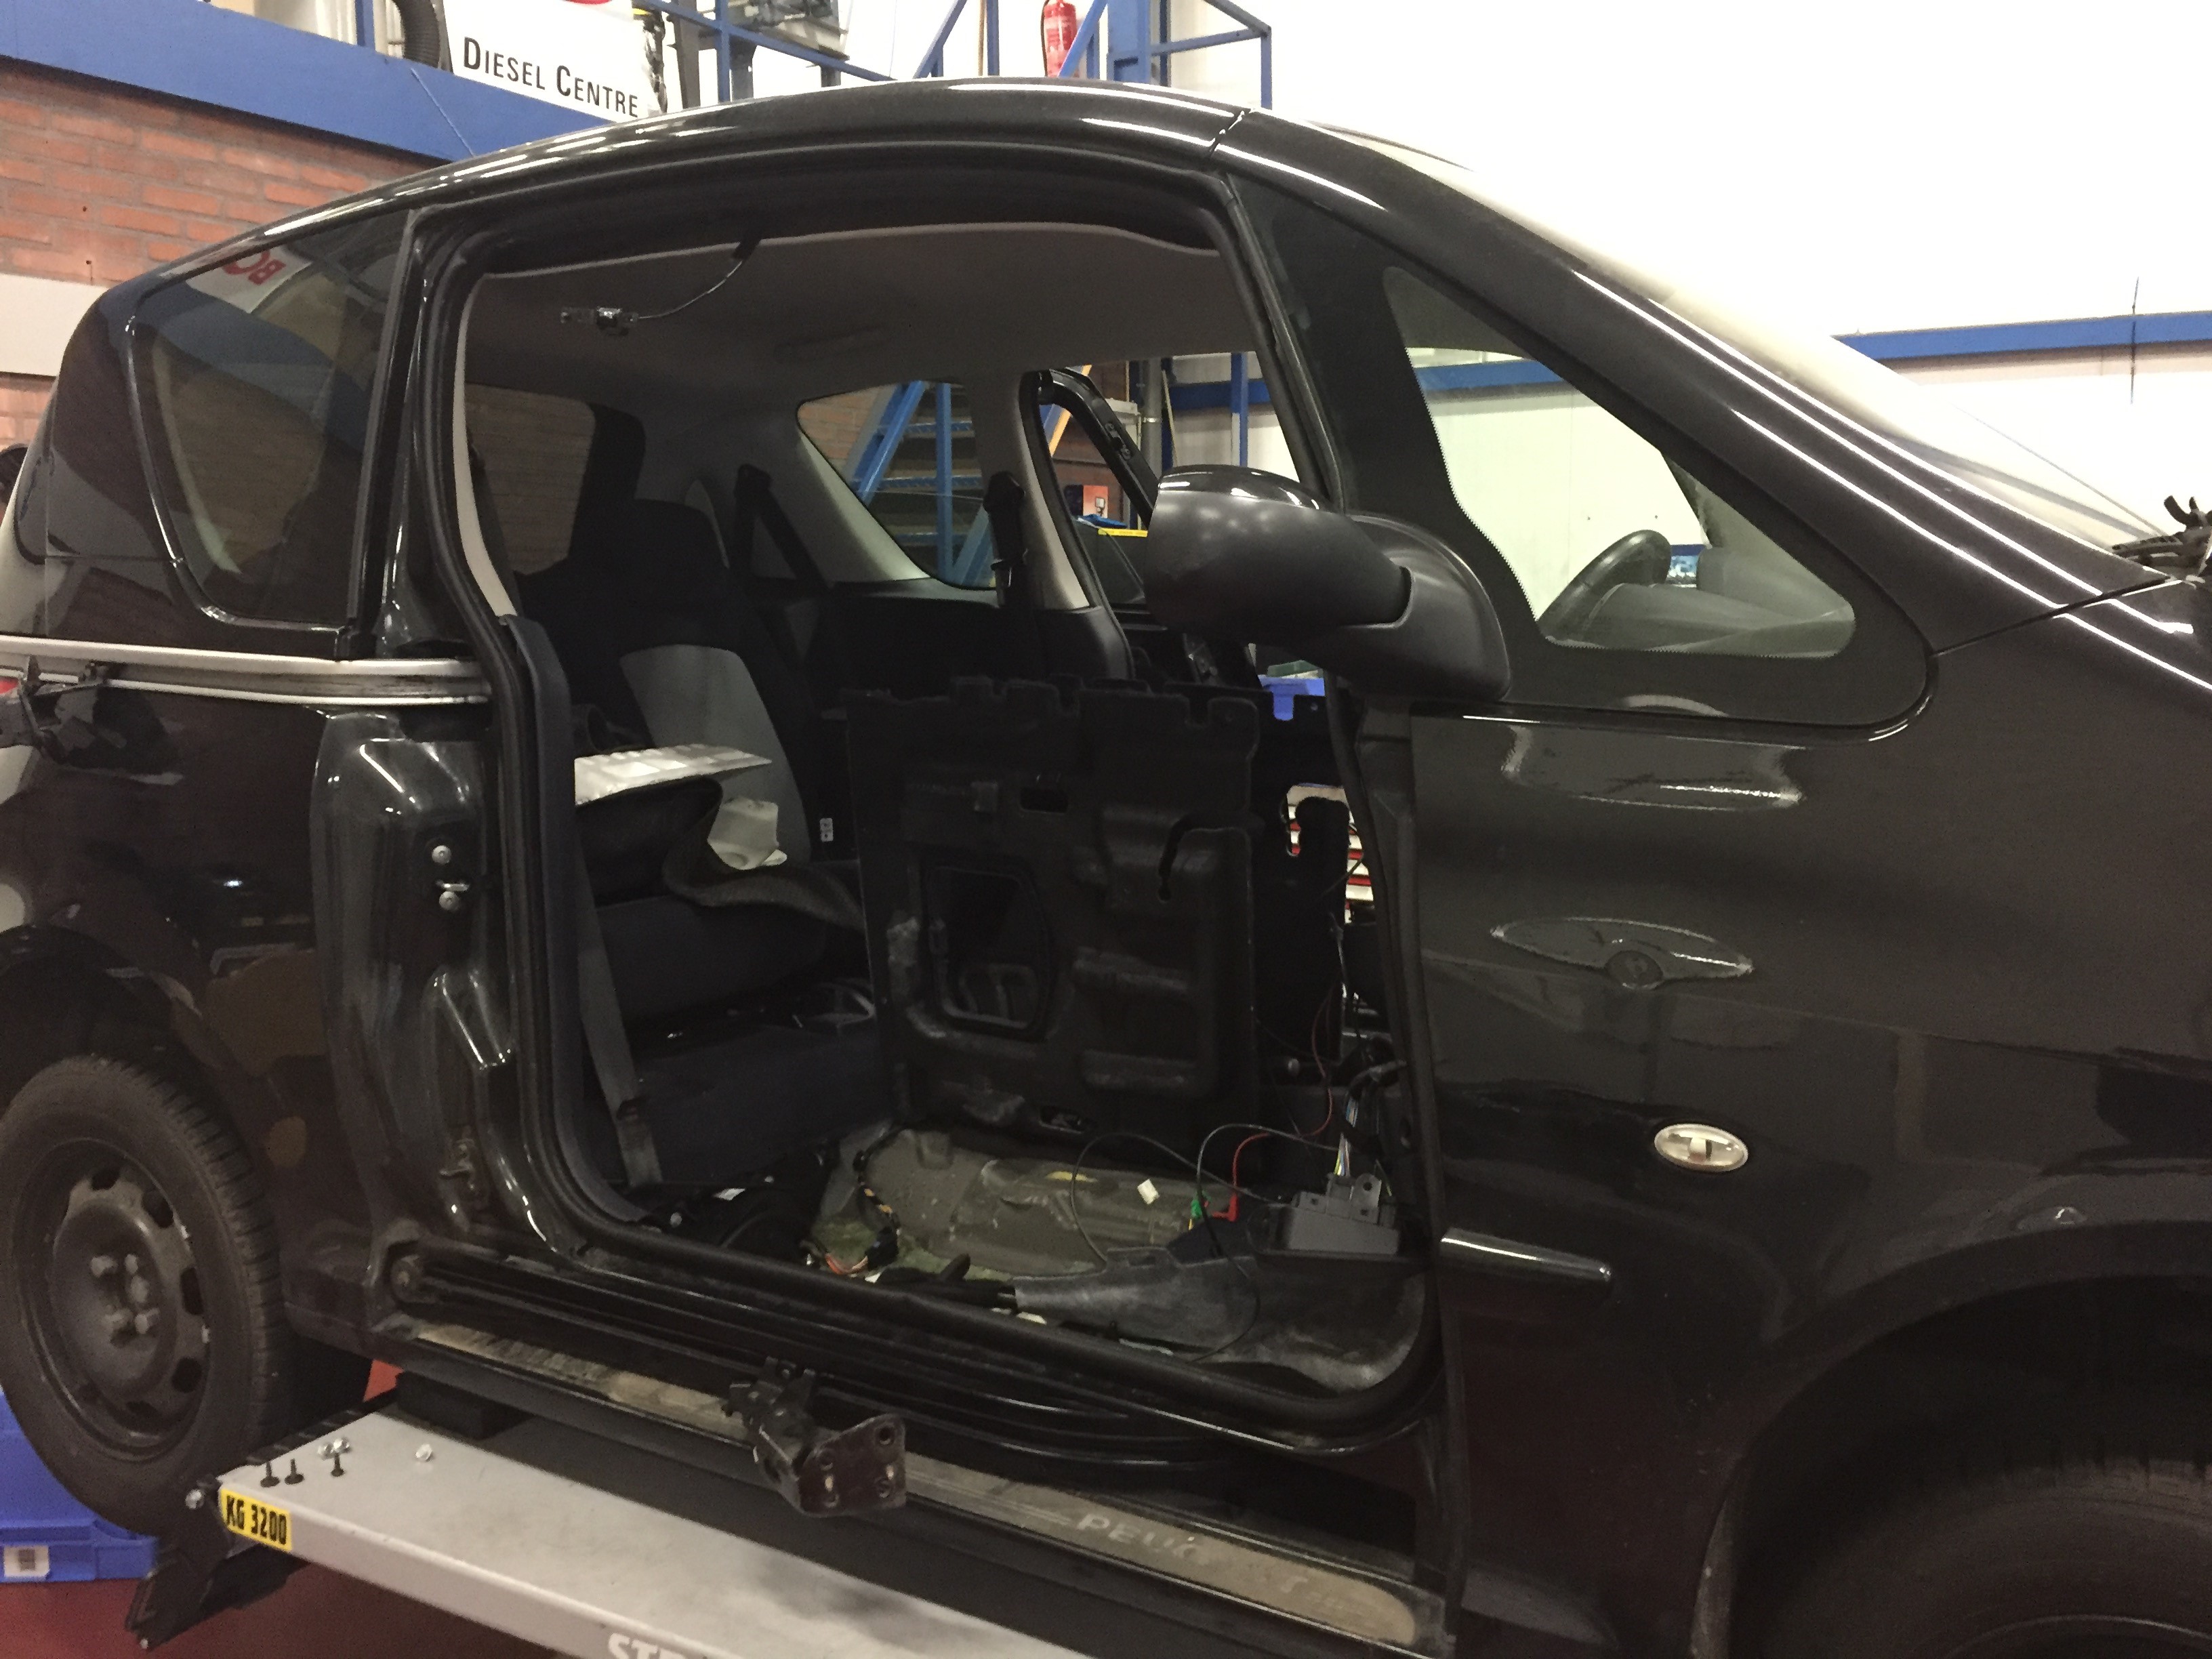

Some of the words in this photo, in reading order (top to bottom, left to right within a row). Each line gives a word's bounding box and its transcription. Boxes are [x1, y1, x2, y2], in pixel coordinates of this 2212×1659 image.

[464, 37, 546, 90] DIESEL
[556, 65, 638, 118] CENTRE
[226, 1494, 245, 1530] KG
[251, 1504, 287, 1545] 3200
